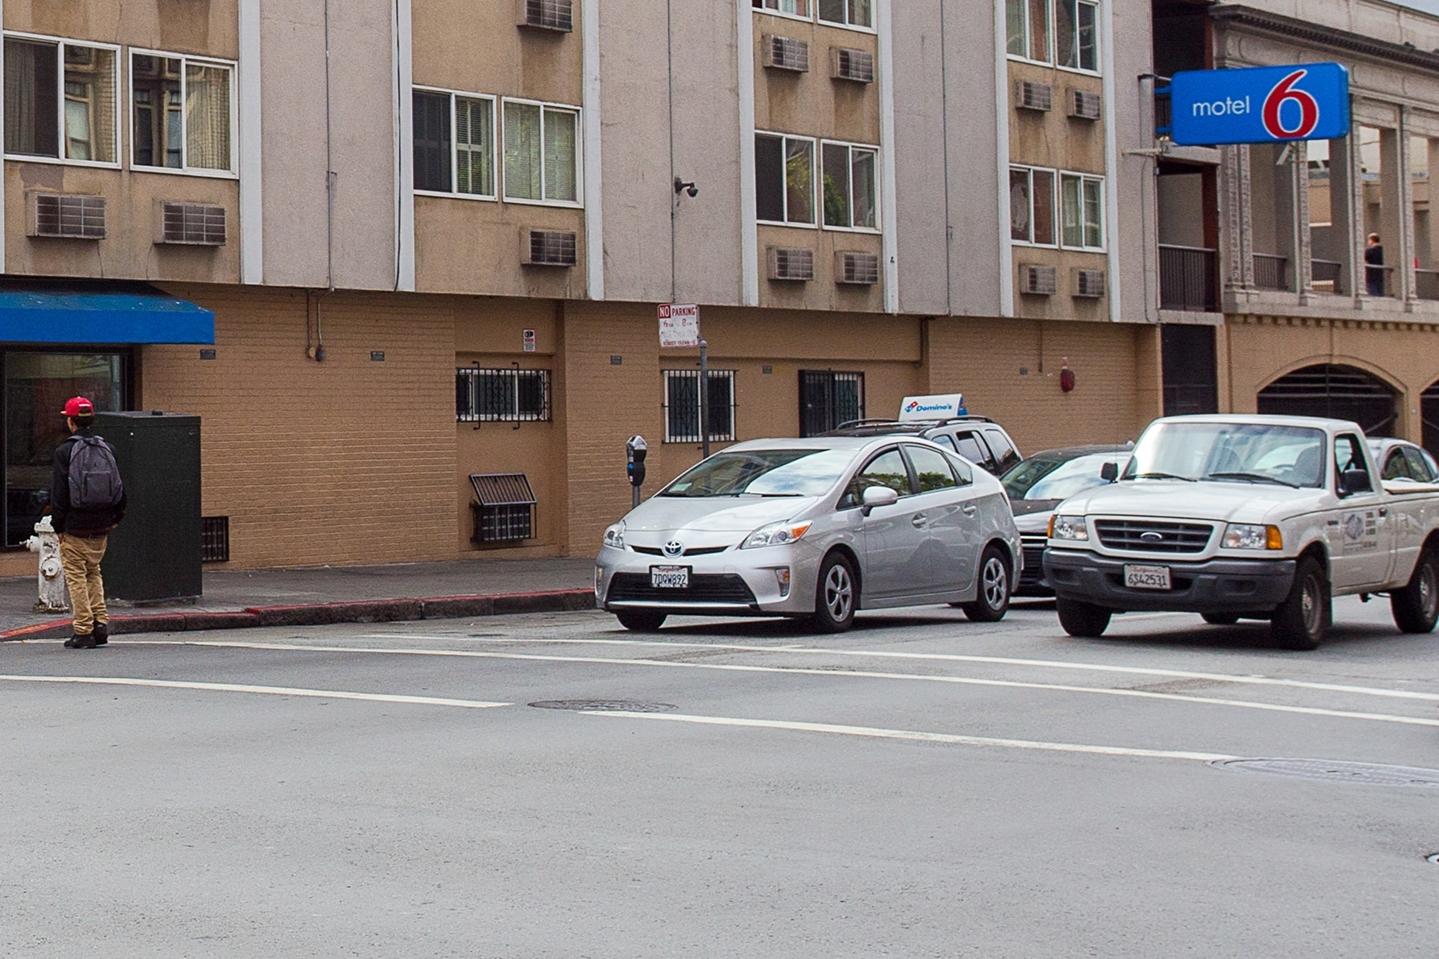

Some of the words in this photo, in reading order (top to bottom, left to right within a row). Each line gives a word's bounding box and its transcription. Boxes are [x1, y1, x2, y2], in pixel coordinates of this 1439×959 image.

[1192, 95, 1250, 117] motel
[1261, 68, 1320, 139] 6
[660, 306, 670, 318] NO
[916, 403, 952, 412] Domino's
